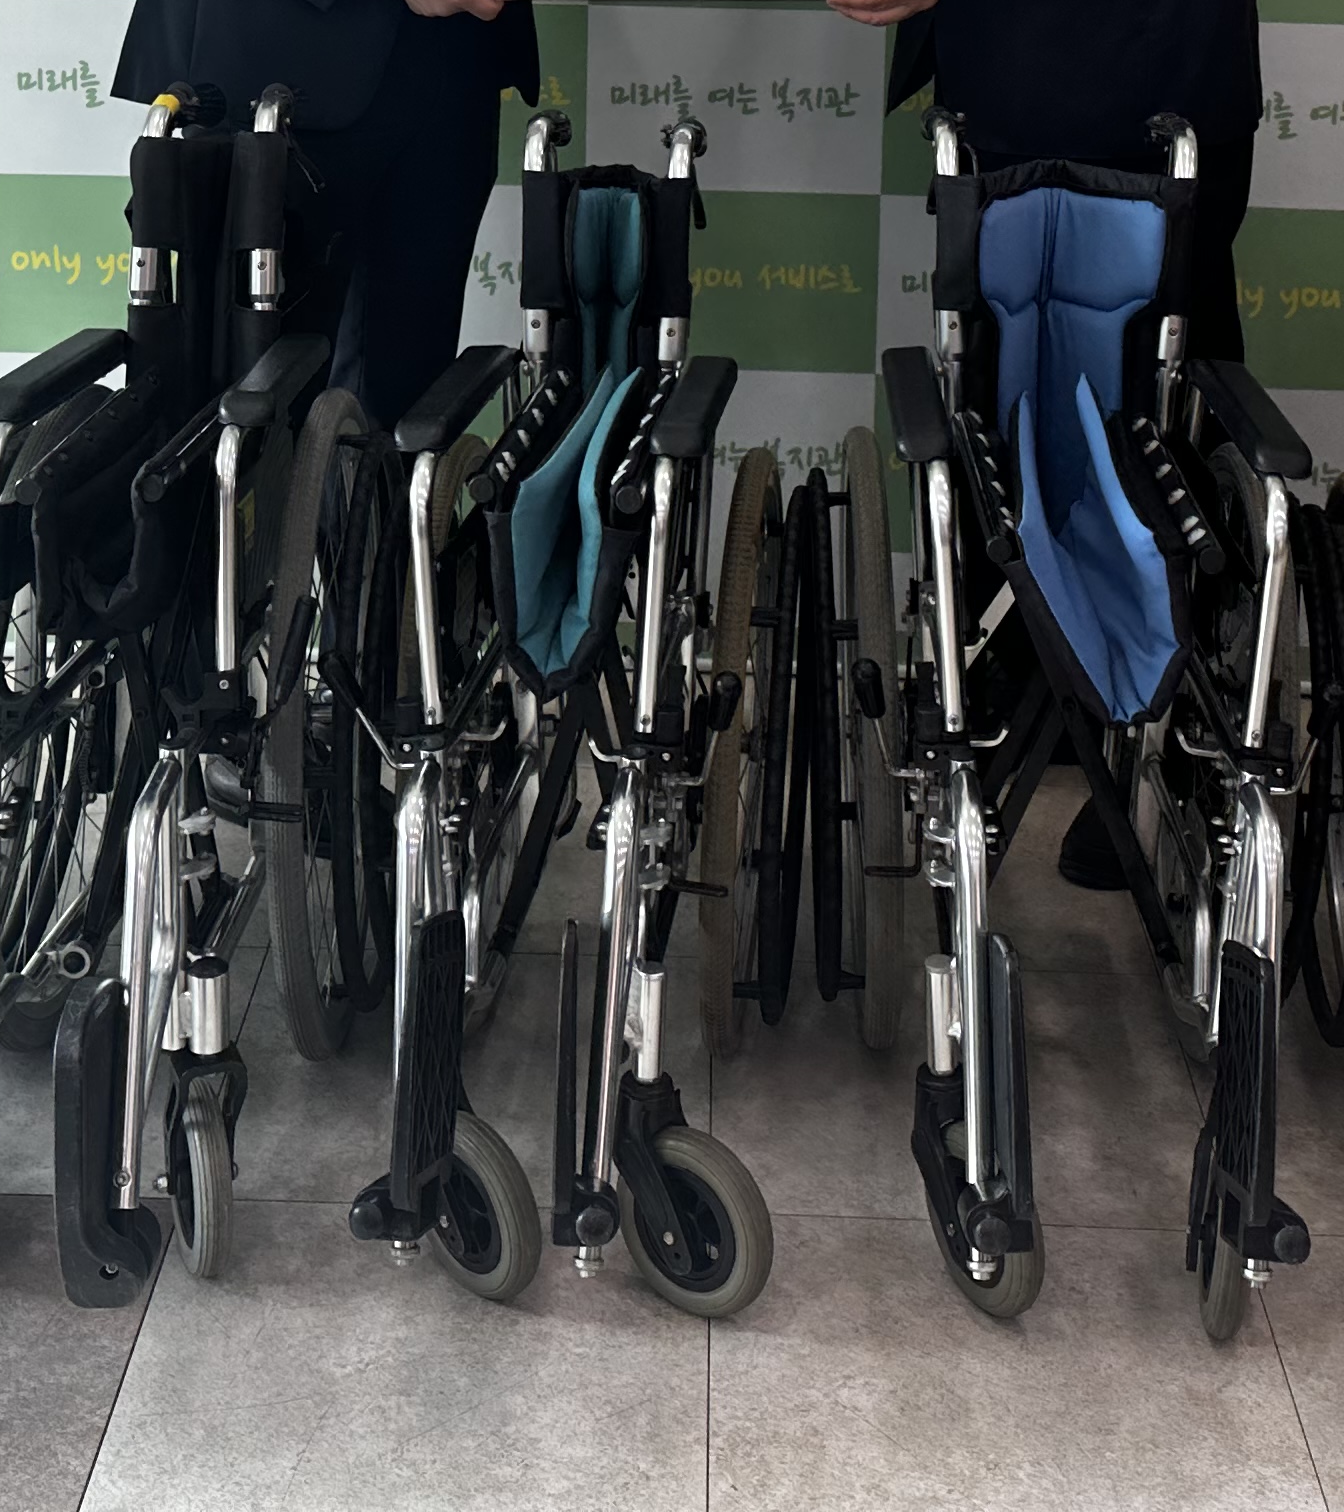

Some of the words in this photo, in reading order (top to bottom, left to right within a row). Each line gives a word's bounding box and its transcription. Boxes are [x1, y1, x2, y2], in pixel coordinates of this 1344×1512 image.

[16, 60, 106, 108] 미래를
[611, 74, 696, 121] 미래를
[708, 87, 759, 115] 여는
[771, 78, 861, 122] 복지관
[11, 246, 80, 284] only
[95, 254, 131, 286] yo
[473, 251, 522, 296] 복지
[758, 263, 862, 293] 서비스로
[1279, 287, 1342, 319] you
